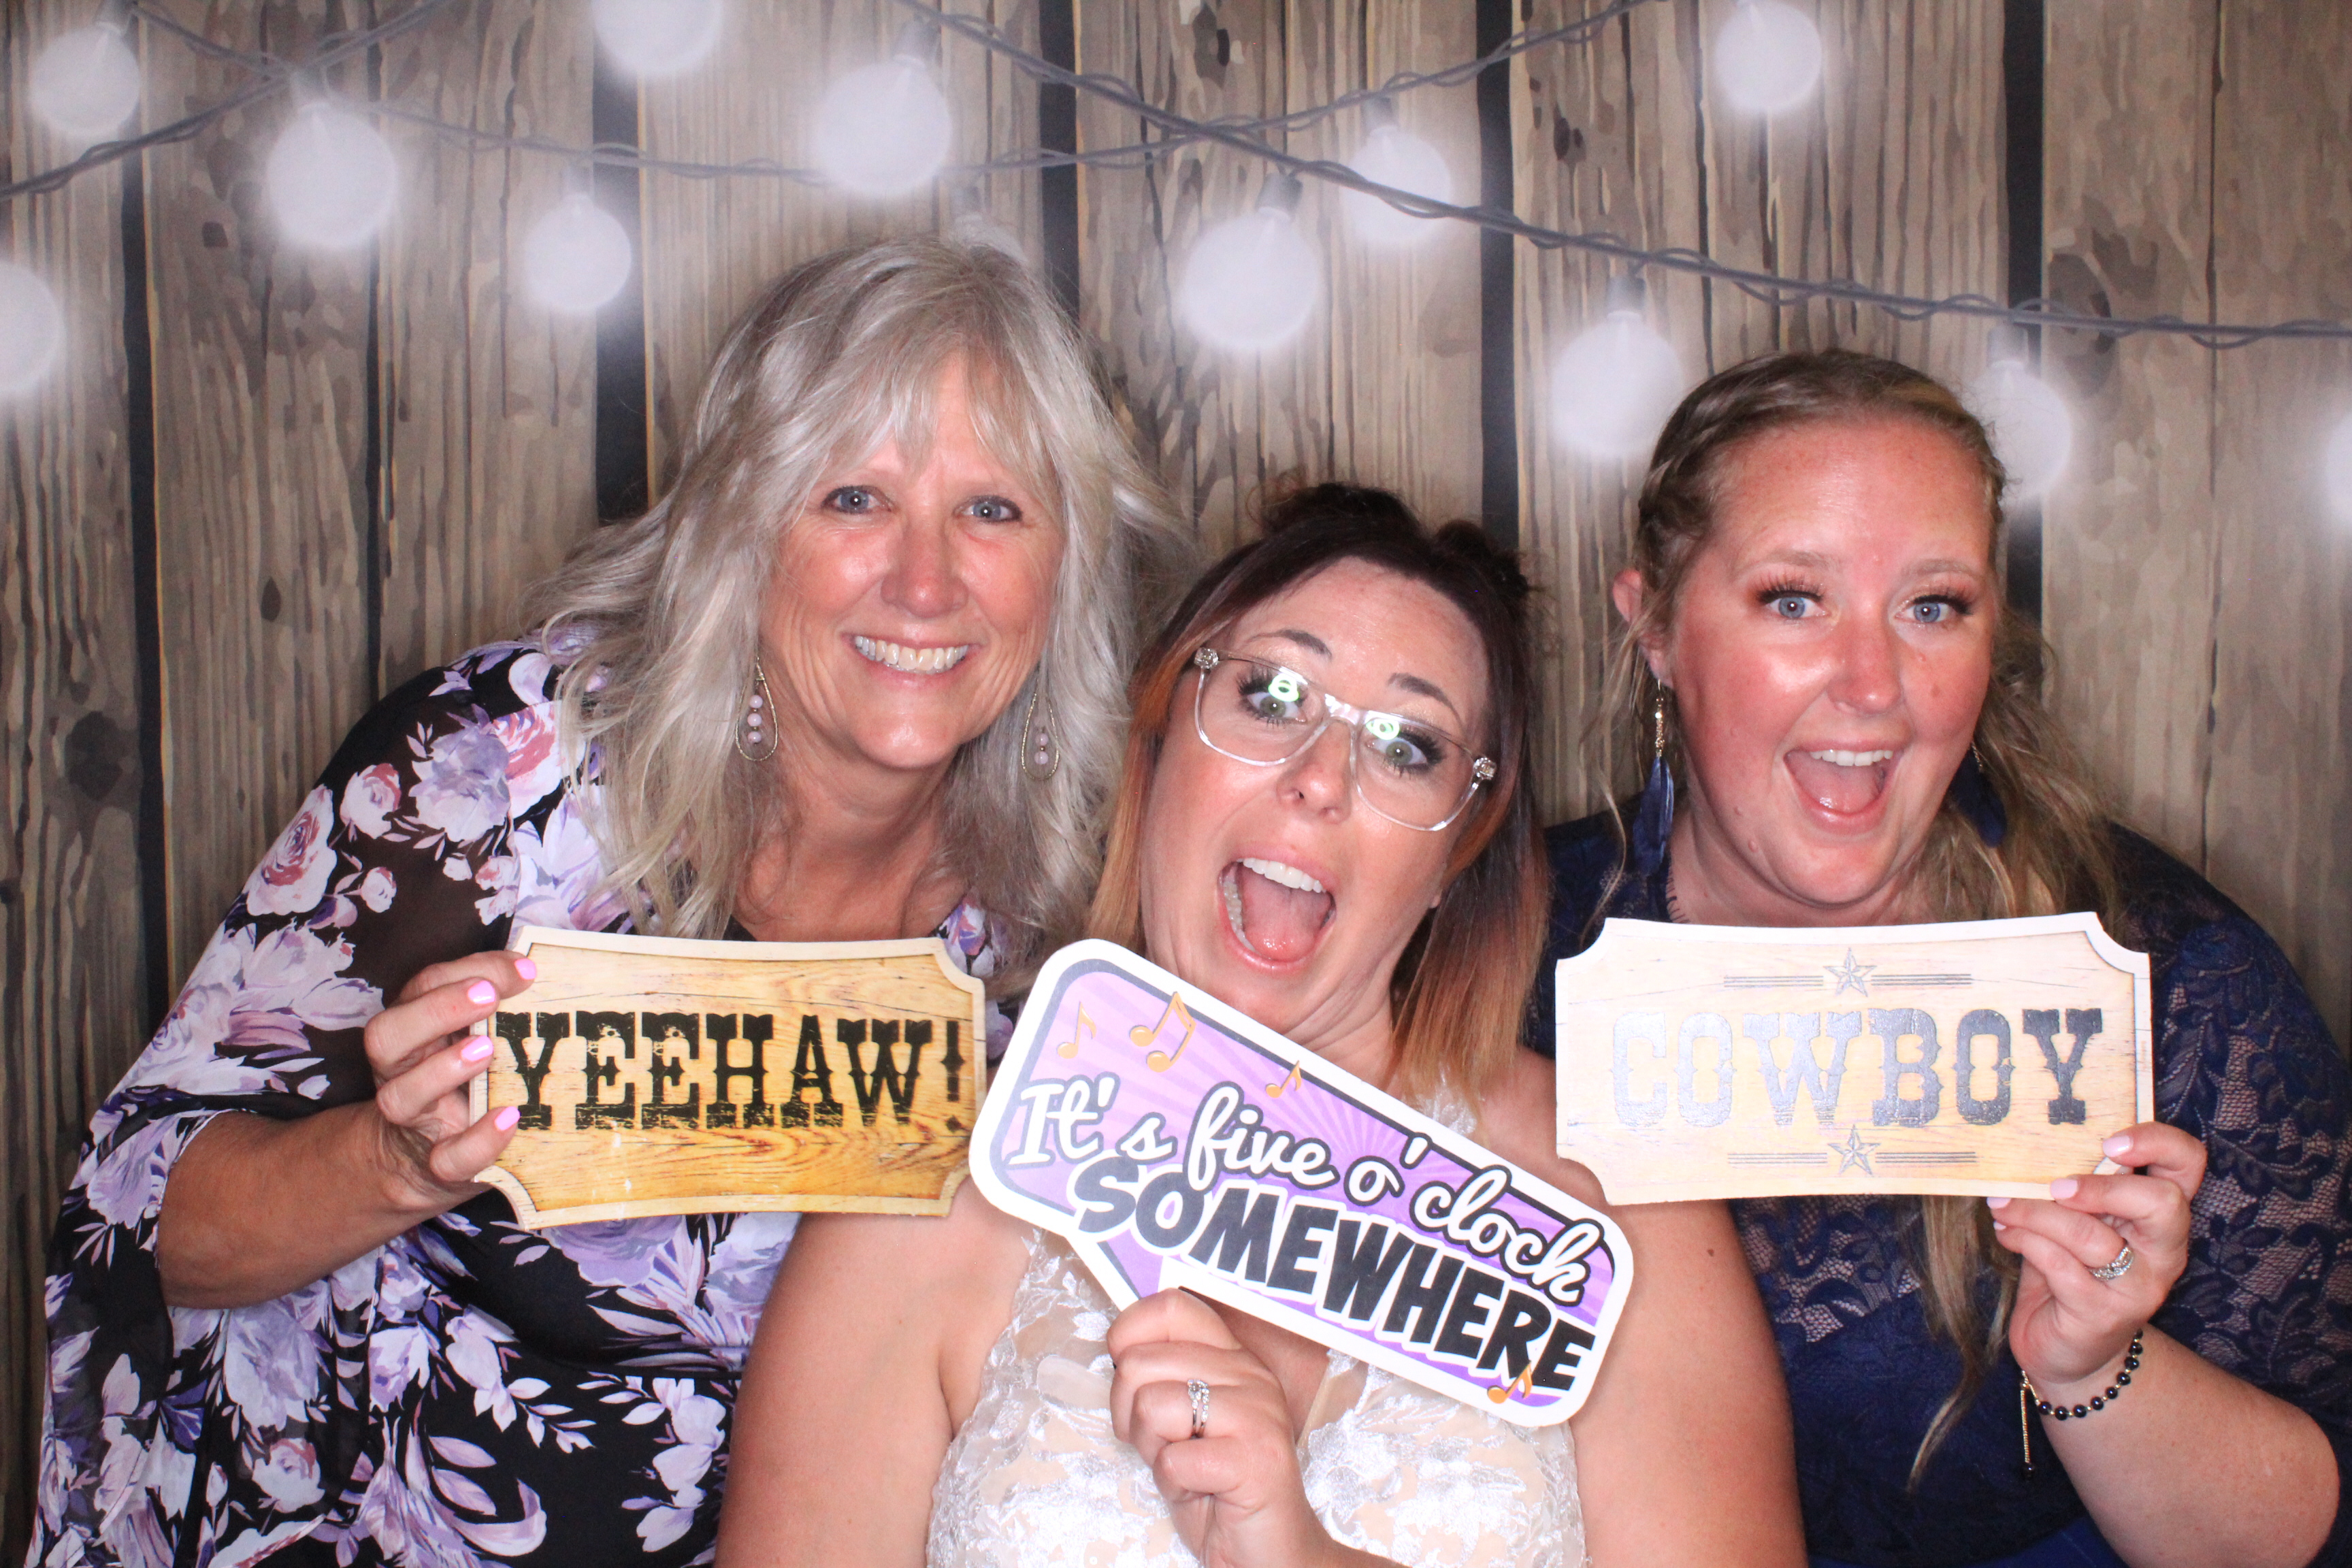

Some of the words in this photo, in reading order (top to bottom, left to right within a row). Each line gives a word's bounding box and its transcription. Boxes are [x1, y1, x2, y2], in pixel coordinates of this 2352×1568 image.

[495, 1011, 966, 1132] YEEHAW!
[1610, 1008, 2103, 1128] COWBOY
[1007, 1073, 1176, 1169] It's
[1183, 1083, 1337, 1195] five
[1073, 1158, 1596, 1391] SOMEWHERE
